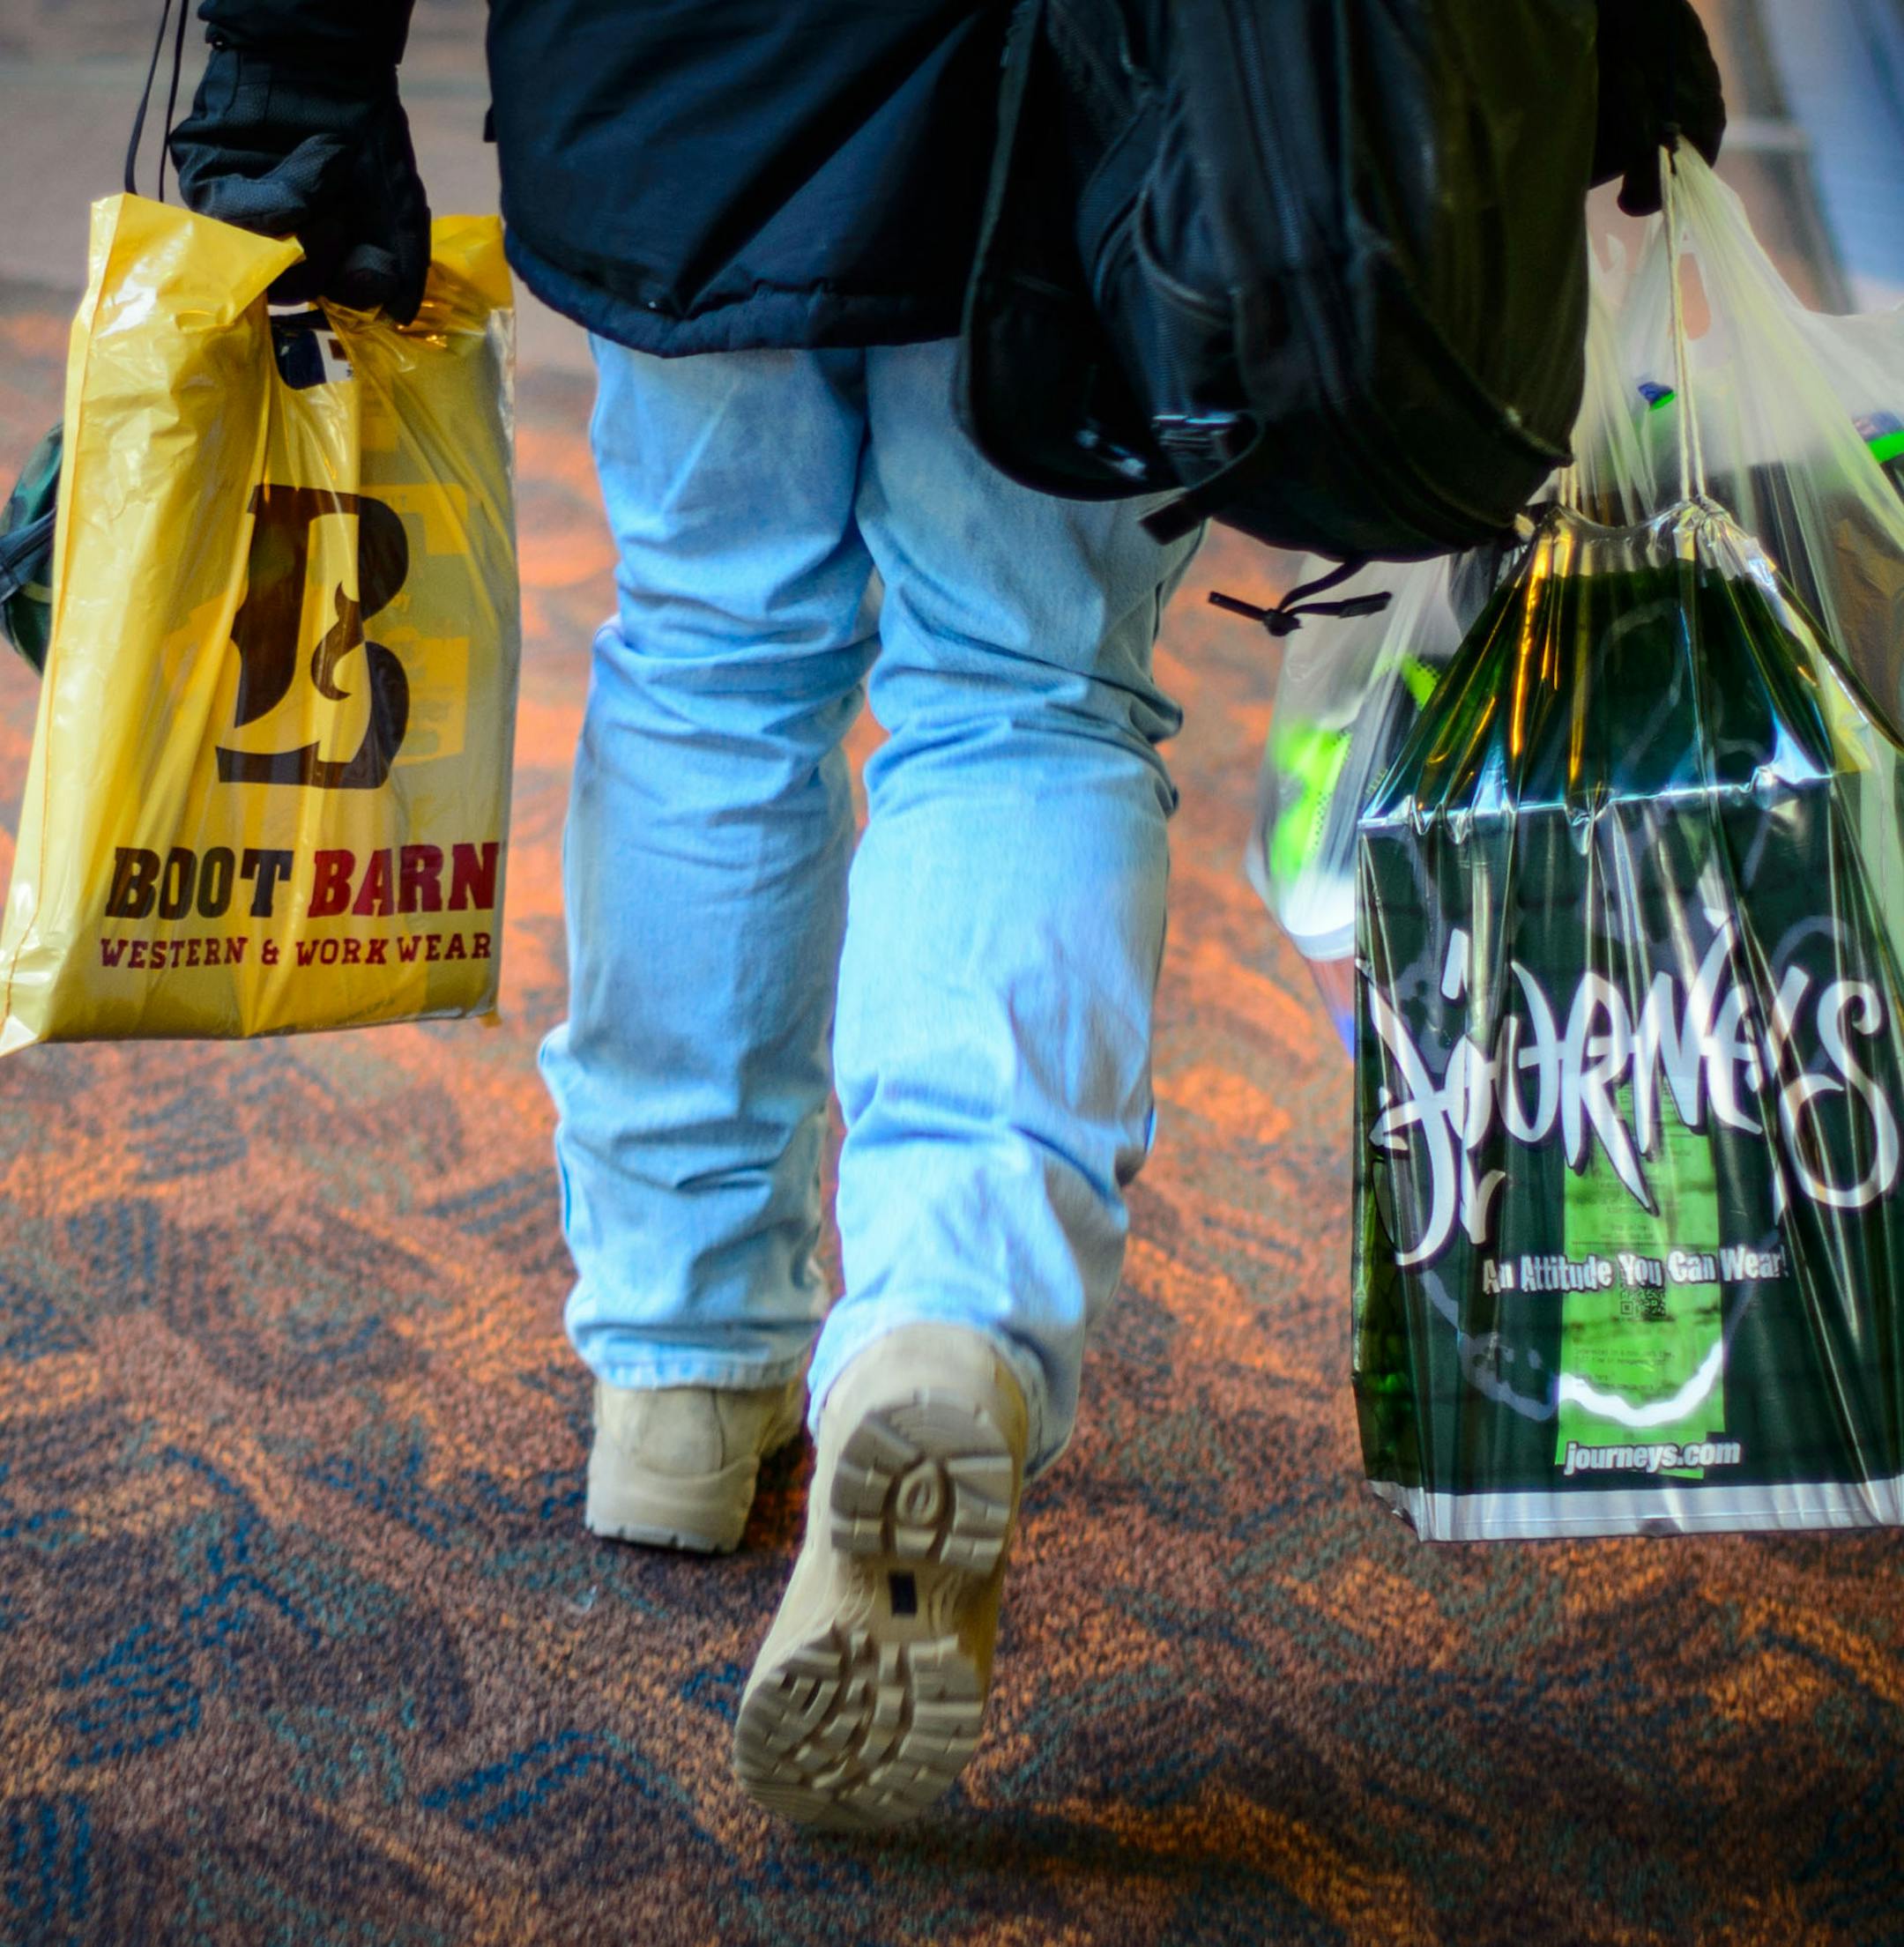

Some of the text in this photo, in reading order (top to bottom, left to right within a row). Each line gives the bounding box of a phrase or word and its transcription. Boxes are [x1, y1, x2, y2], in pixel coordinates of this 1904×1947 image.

[105, 842, 500, 920] BOOT BARN
[100, 937, 249, 969] WESTERN
[261, 939, 279, 965] &
[1483, 1259, 1515, 1296] An
[1520, 1254, 1613, 1293] Attitude
[1617, 1252, 1663, 1287] You
[1667, 1250, 1717, 1283] Can
[1563, 1440, 1741, 1476] journeys.com
